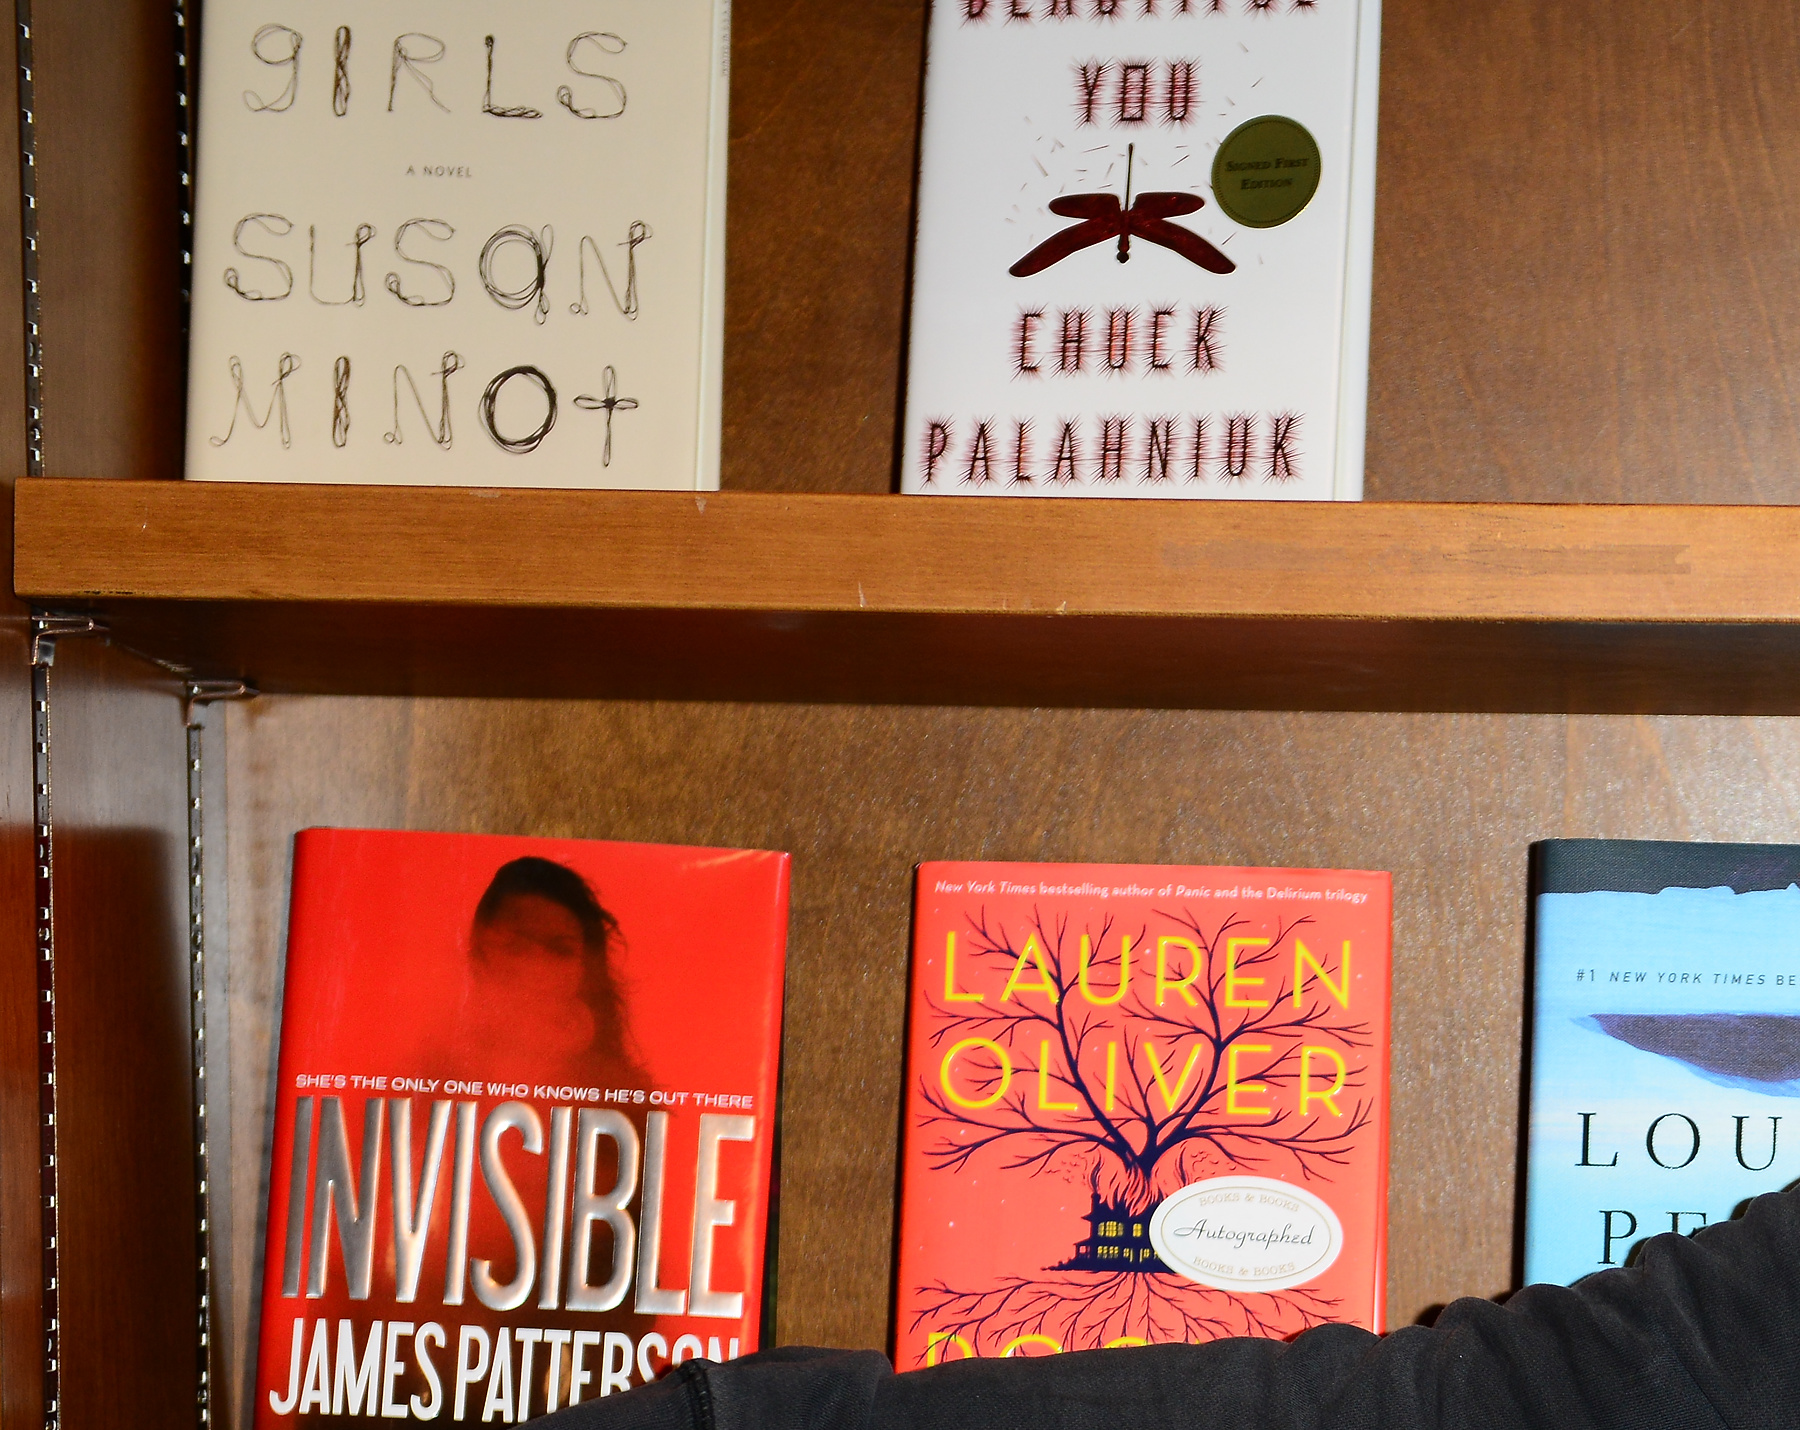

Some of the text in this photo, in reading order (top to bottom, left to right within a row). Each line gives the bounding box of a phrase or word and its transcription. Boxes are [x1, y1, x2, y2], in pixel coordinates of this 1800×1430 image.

[1074, 59, 1201, 127] YOU
[406, 165, 474, 178] A NOVEL
[1014, 306, 1222, 376] CHUCK
[920, 413, 1302, 484] PALAHNIUK
[934, 880, 1368, 904] New York Times bestselling author of Panic and the Delirium trilogy
[944, 931, 1351, 1010] LAUREN
[1576, 969, 1596, 982] #1
[1610, 971, 1647, 984] NEW
[1658, 972, 1703, 984] YORK
[1713, 973, 1766, 986] TIMES
[295, 1074, 753, 1109] SHE'S THE ONLY ONE WHO KNOWS HE'S OUT THERE
[939, 1037, 1348, 1118] OLIVER
[281, 1096, 755, 1318] INVISIBLE
[1199, 1192, 1240, 1207] BOOKS
[1259, 1194, 1300, 1213] BOOKS
[1173, 1218, 1316, 1250] Autographed
[1194, 1256, 1234, 1275] BOOKS
[1253, 1262, 1296, 1276] BOOKS
[270, 1317, 739, 1422] JAMES PATTERS
